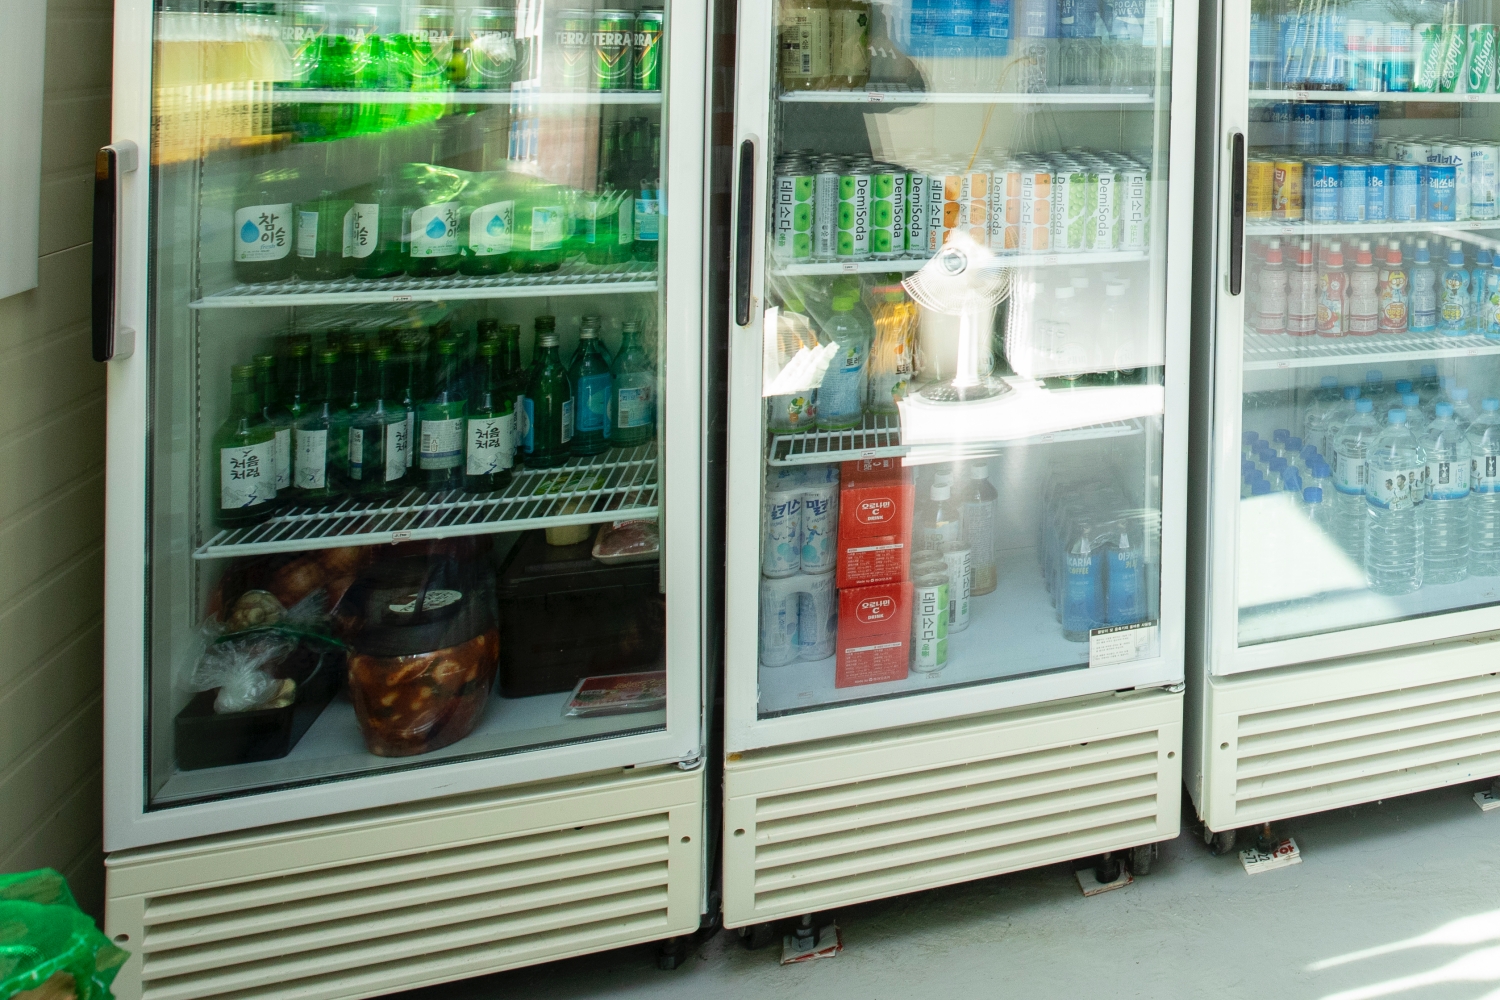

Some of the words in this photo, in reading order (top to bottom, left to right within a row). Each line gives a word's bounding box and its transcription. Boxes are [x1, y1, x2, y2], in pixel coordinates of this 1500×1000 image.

[591, 31, 632, 47] TERRA
[778, 179, 794, 233] 데미소다
[855, 179, 868, 242] DemiSoda
[911, 177, 923, 238] DemiSoda
[231, 455, 260, 468] 처음
[230, 466, 261, 480] 처럼
[860, 502, 892, 511] 오로나민
